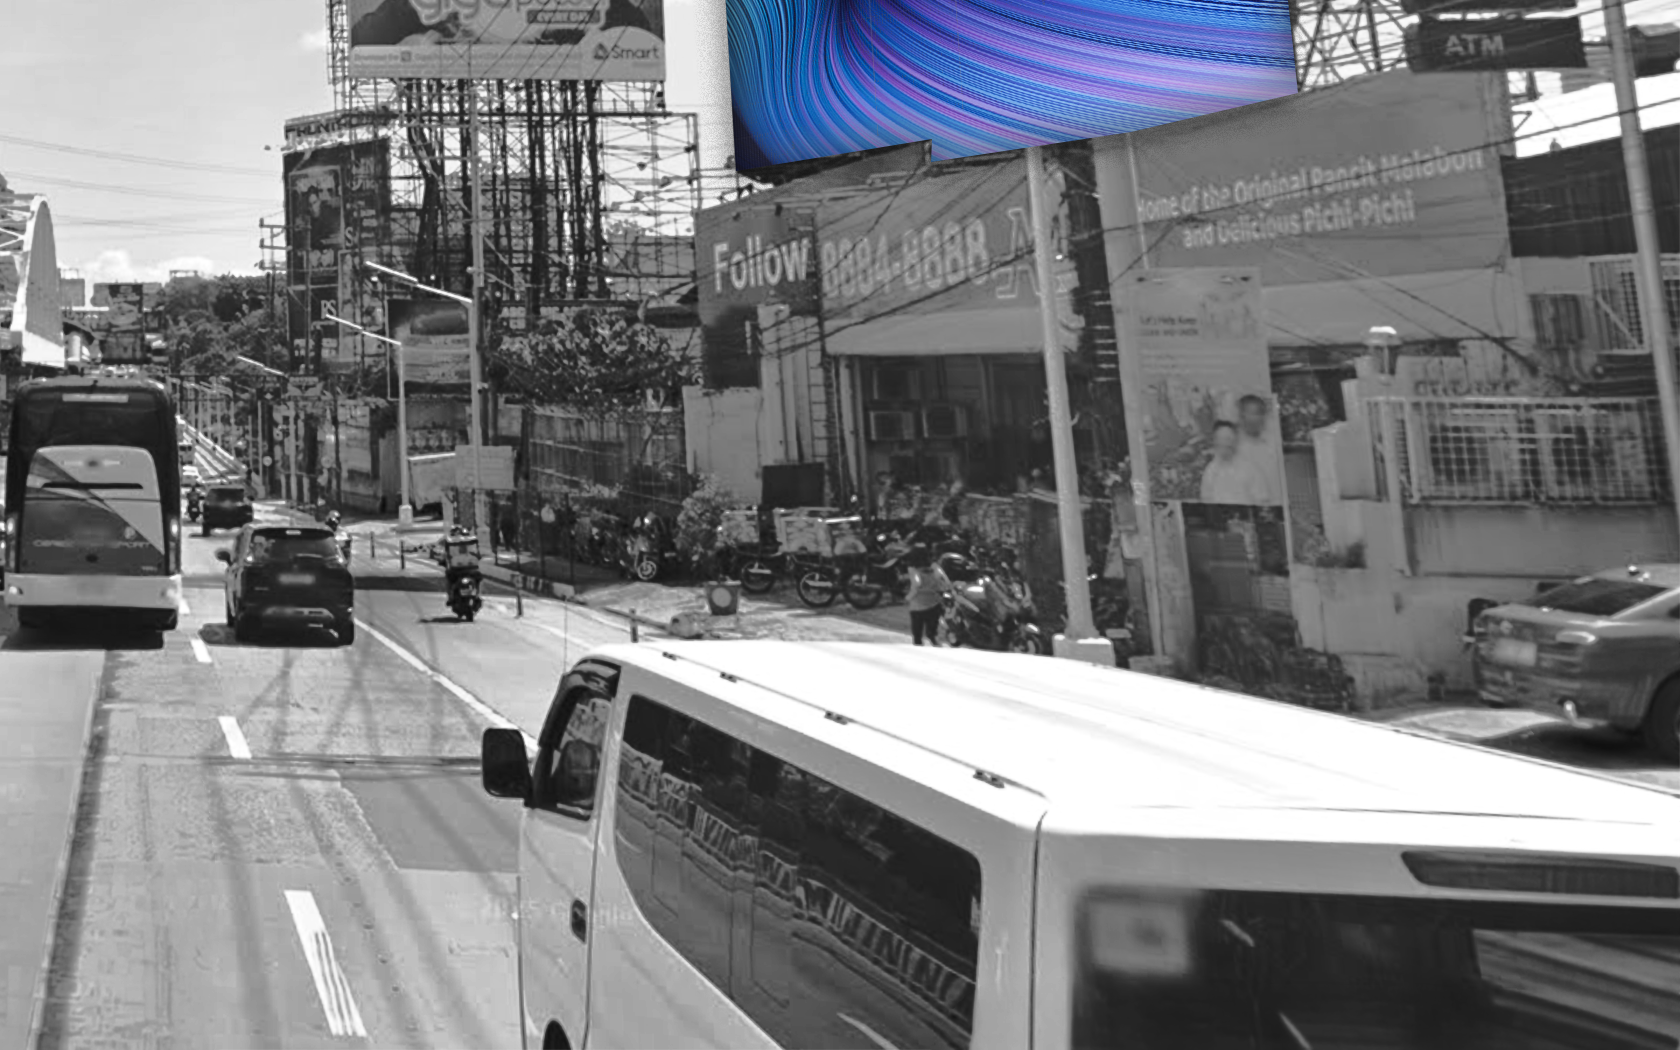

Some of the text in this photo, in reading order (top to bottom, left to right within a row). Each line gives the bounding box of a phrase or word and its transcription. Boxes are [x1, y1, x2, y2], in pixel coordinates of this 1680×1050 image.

[611, 46, 660, 59] Smart
[1444, 33, 1505, 58] ATM
[1138, 146, 1483, 221] Home of the Original Pancit Malabon
[1183, 189, 1416, 248] and Delicious Pichi-Pichi
[713, 234, 809, 292] Follow
